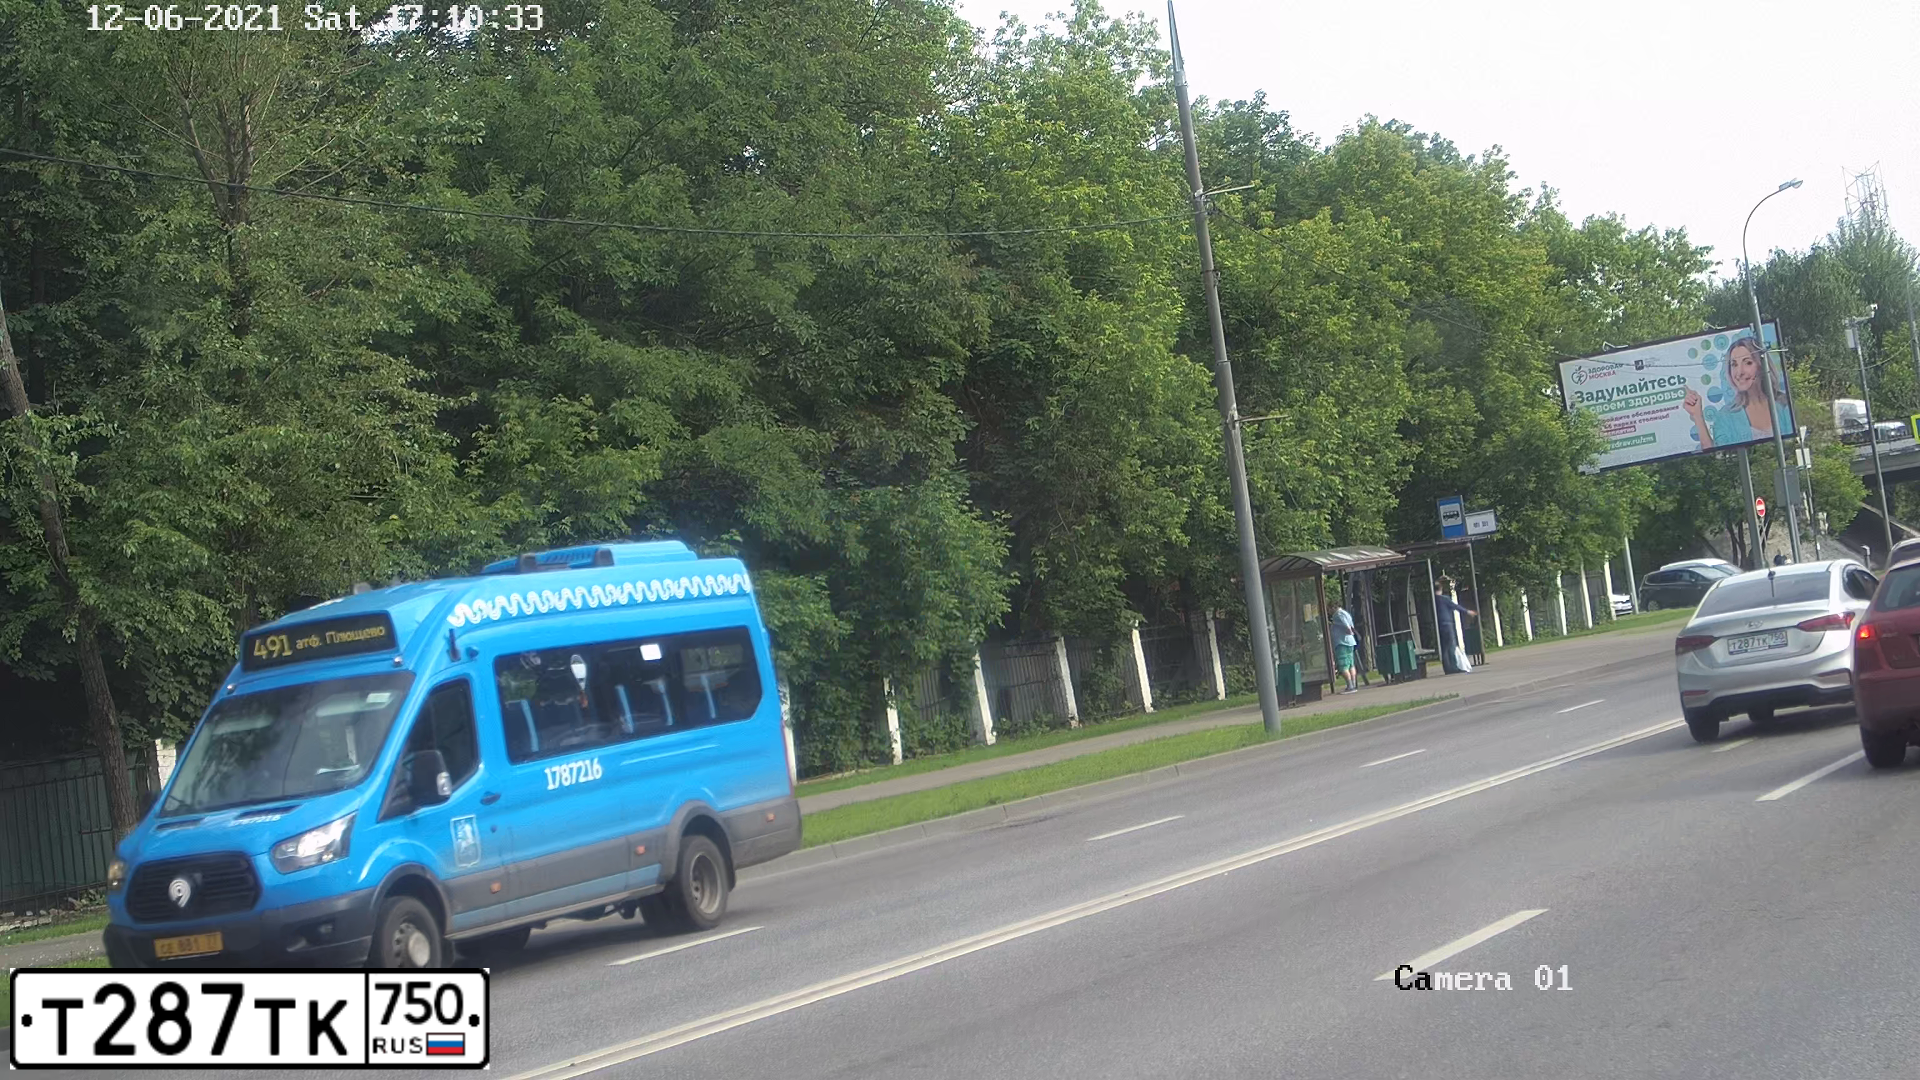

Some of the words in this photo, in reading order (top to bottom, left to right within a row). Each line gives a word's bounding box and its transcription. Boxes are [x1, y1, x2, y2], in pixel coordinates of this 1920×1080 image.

[1588, 370, 1616, 380] МОСКВА
[1574, 374, 1687, 404] Задумайтесь
[1628, 389, 1685, 406] здоровье
[253, 634, 292, 659] 491
[544, 757, 602, 790] 1787216
